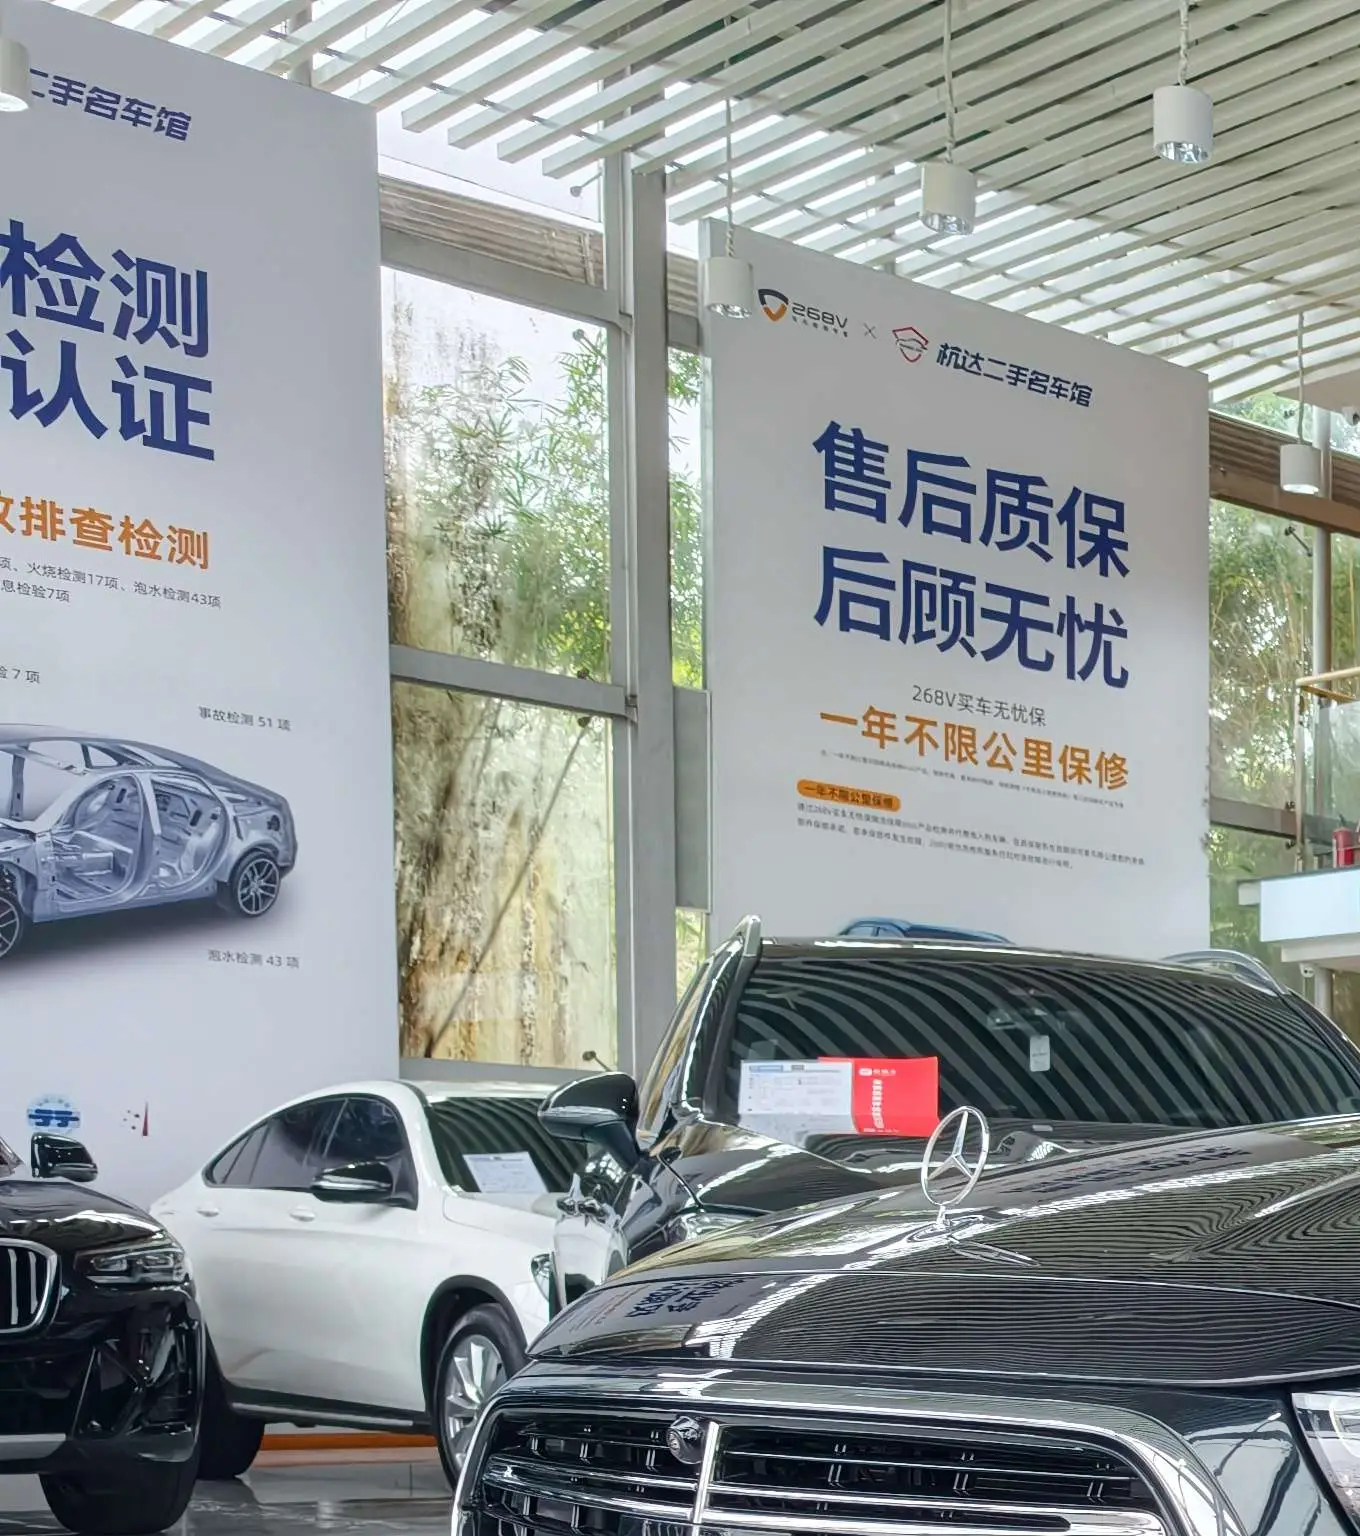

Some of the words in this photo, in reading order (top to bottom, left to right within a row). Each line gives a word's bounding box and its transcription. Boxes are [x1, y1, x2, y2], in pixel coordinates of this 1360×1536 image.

[0, 218, 209, 358] 检测
[792, 302, 848, 329] 268V
[0, 329, 215, 461] 认证
[936, 342, 1093, 407] 杭达二手名车馆
[812, 420, 1130, 578] 售后质保
[813, 545, 1130, 689] 后顾无忧
[198, 705, 254, 728] 事故检测
[258, 714, 275, 729] 51
[819, 705, 1130, 790] 一年不限公里保修
[912, 684, 1046, 727] 268V买车无忧保
